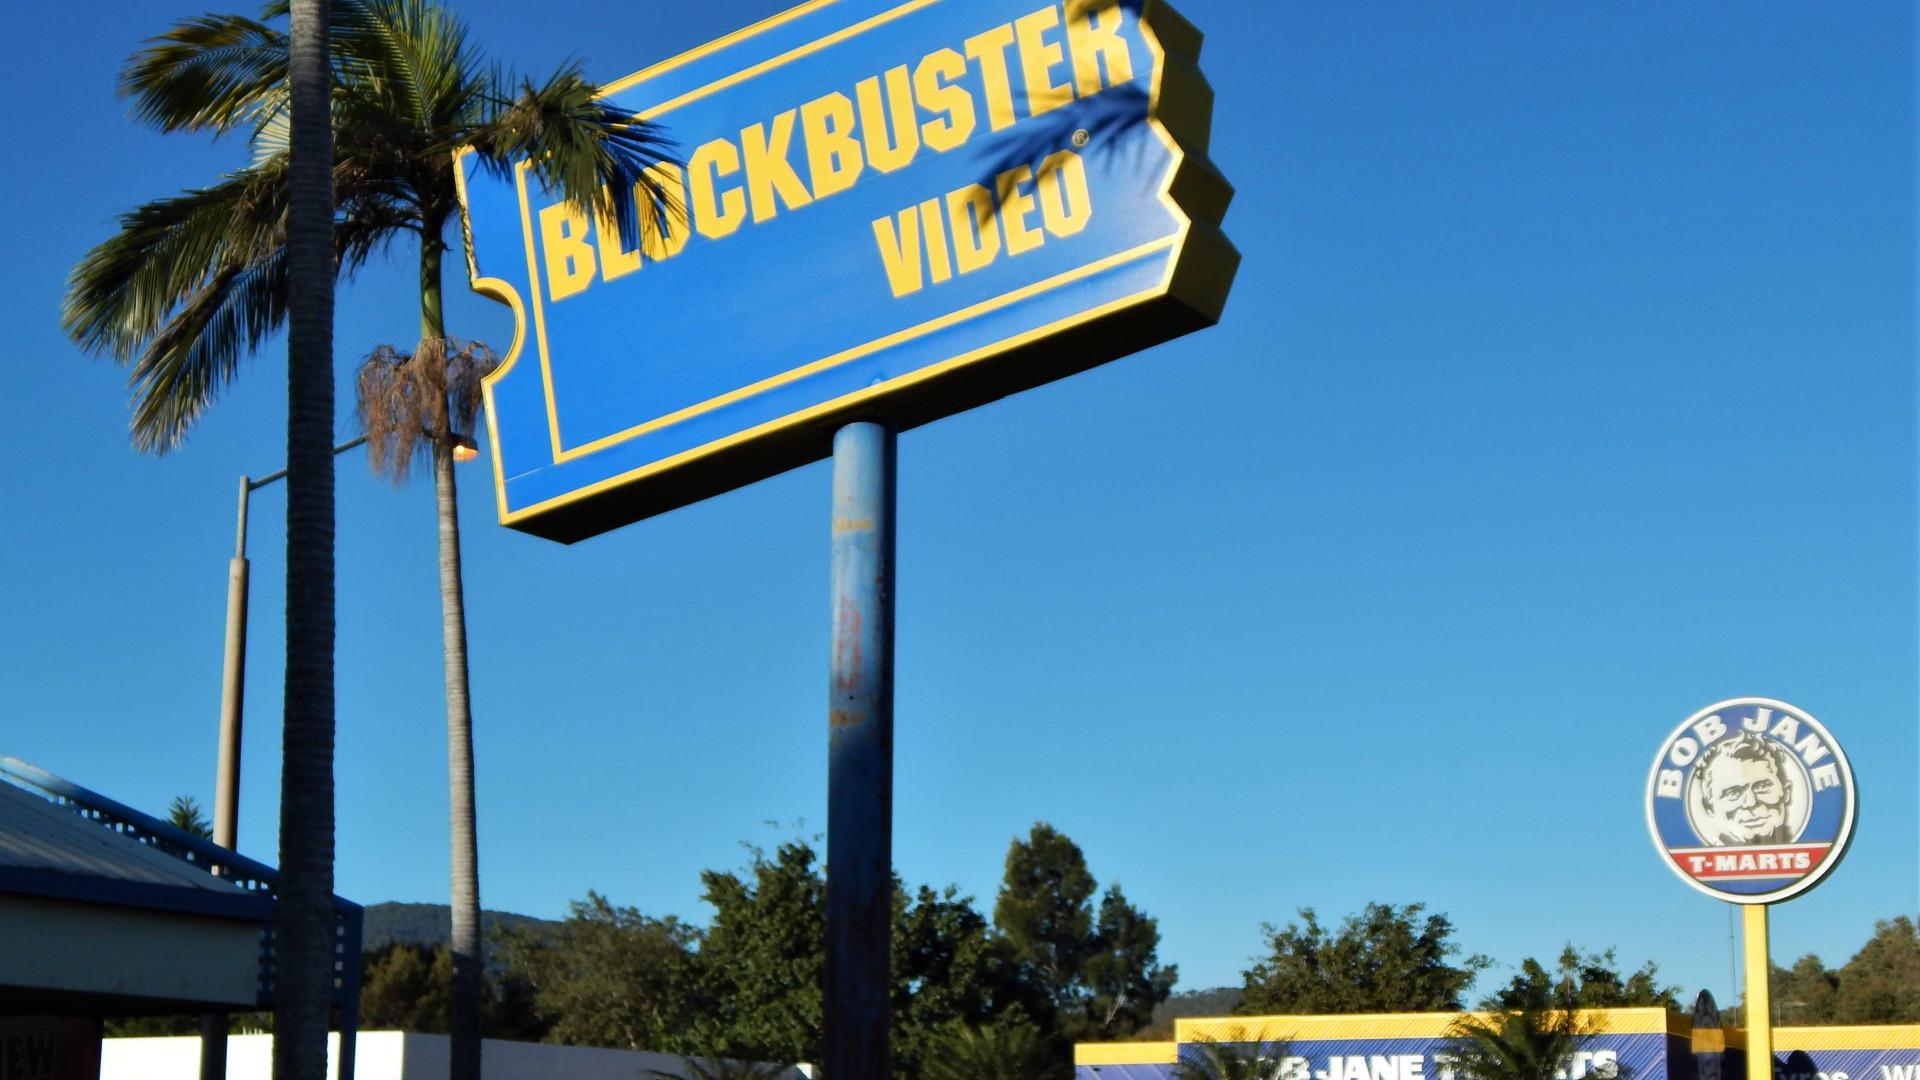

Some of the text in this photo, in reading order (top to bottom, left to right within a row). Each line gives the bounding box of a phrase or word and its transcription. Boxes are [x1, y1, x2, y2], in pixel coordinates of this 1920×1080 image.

[538, 0, 1133, 302] BLOCKBUSTER
[872, 148, 1092, 298] VIDEO
[1657, 708, 1841, 799] BOB JANE
[1689, 852, 1811, 874] T-MARTS
[1316, 1055, 1426, 1080] JANE
